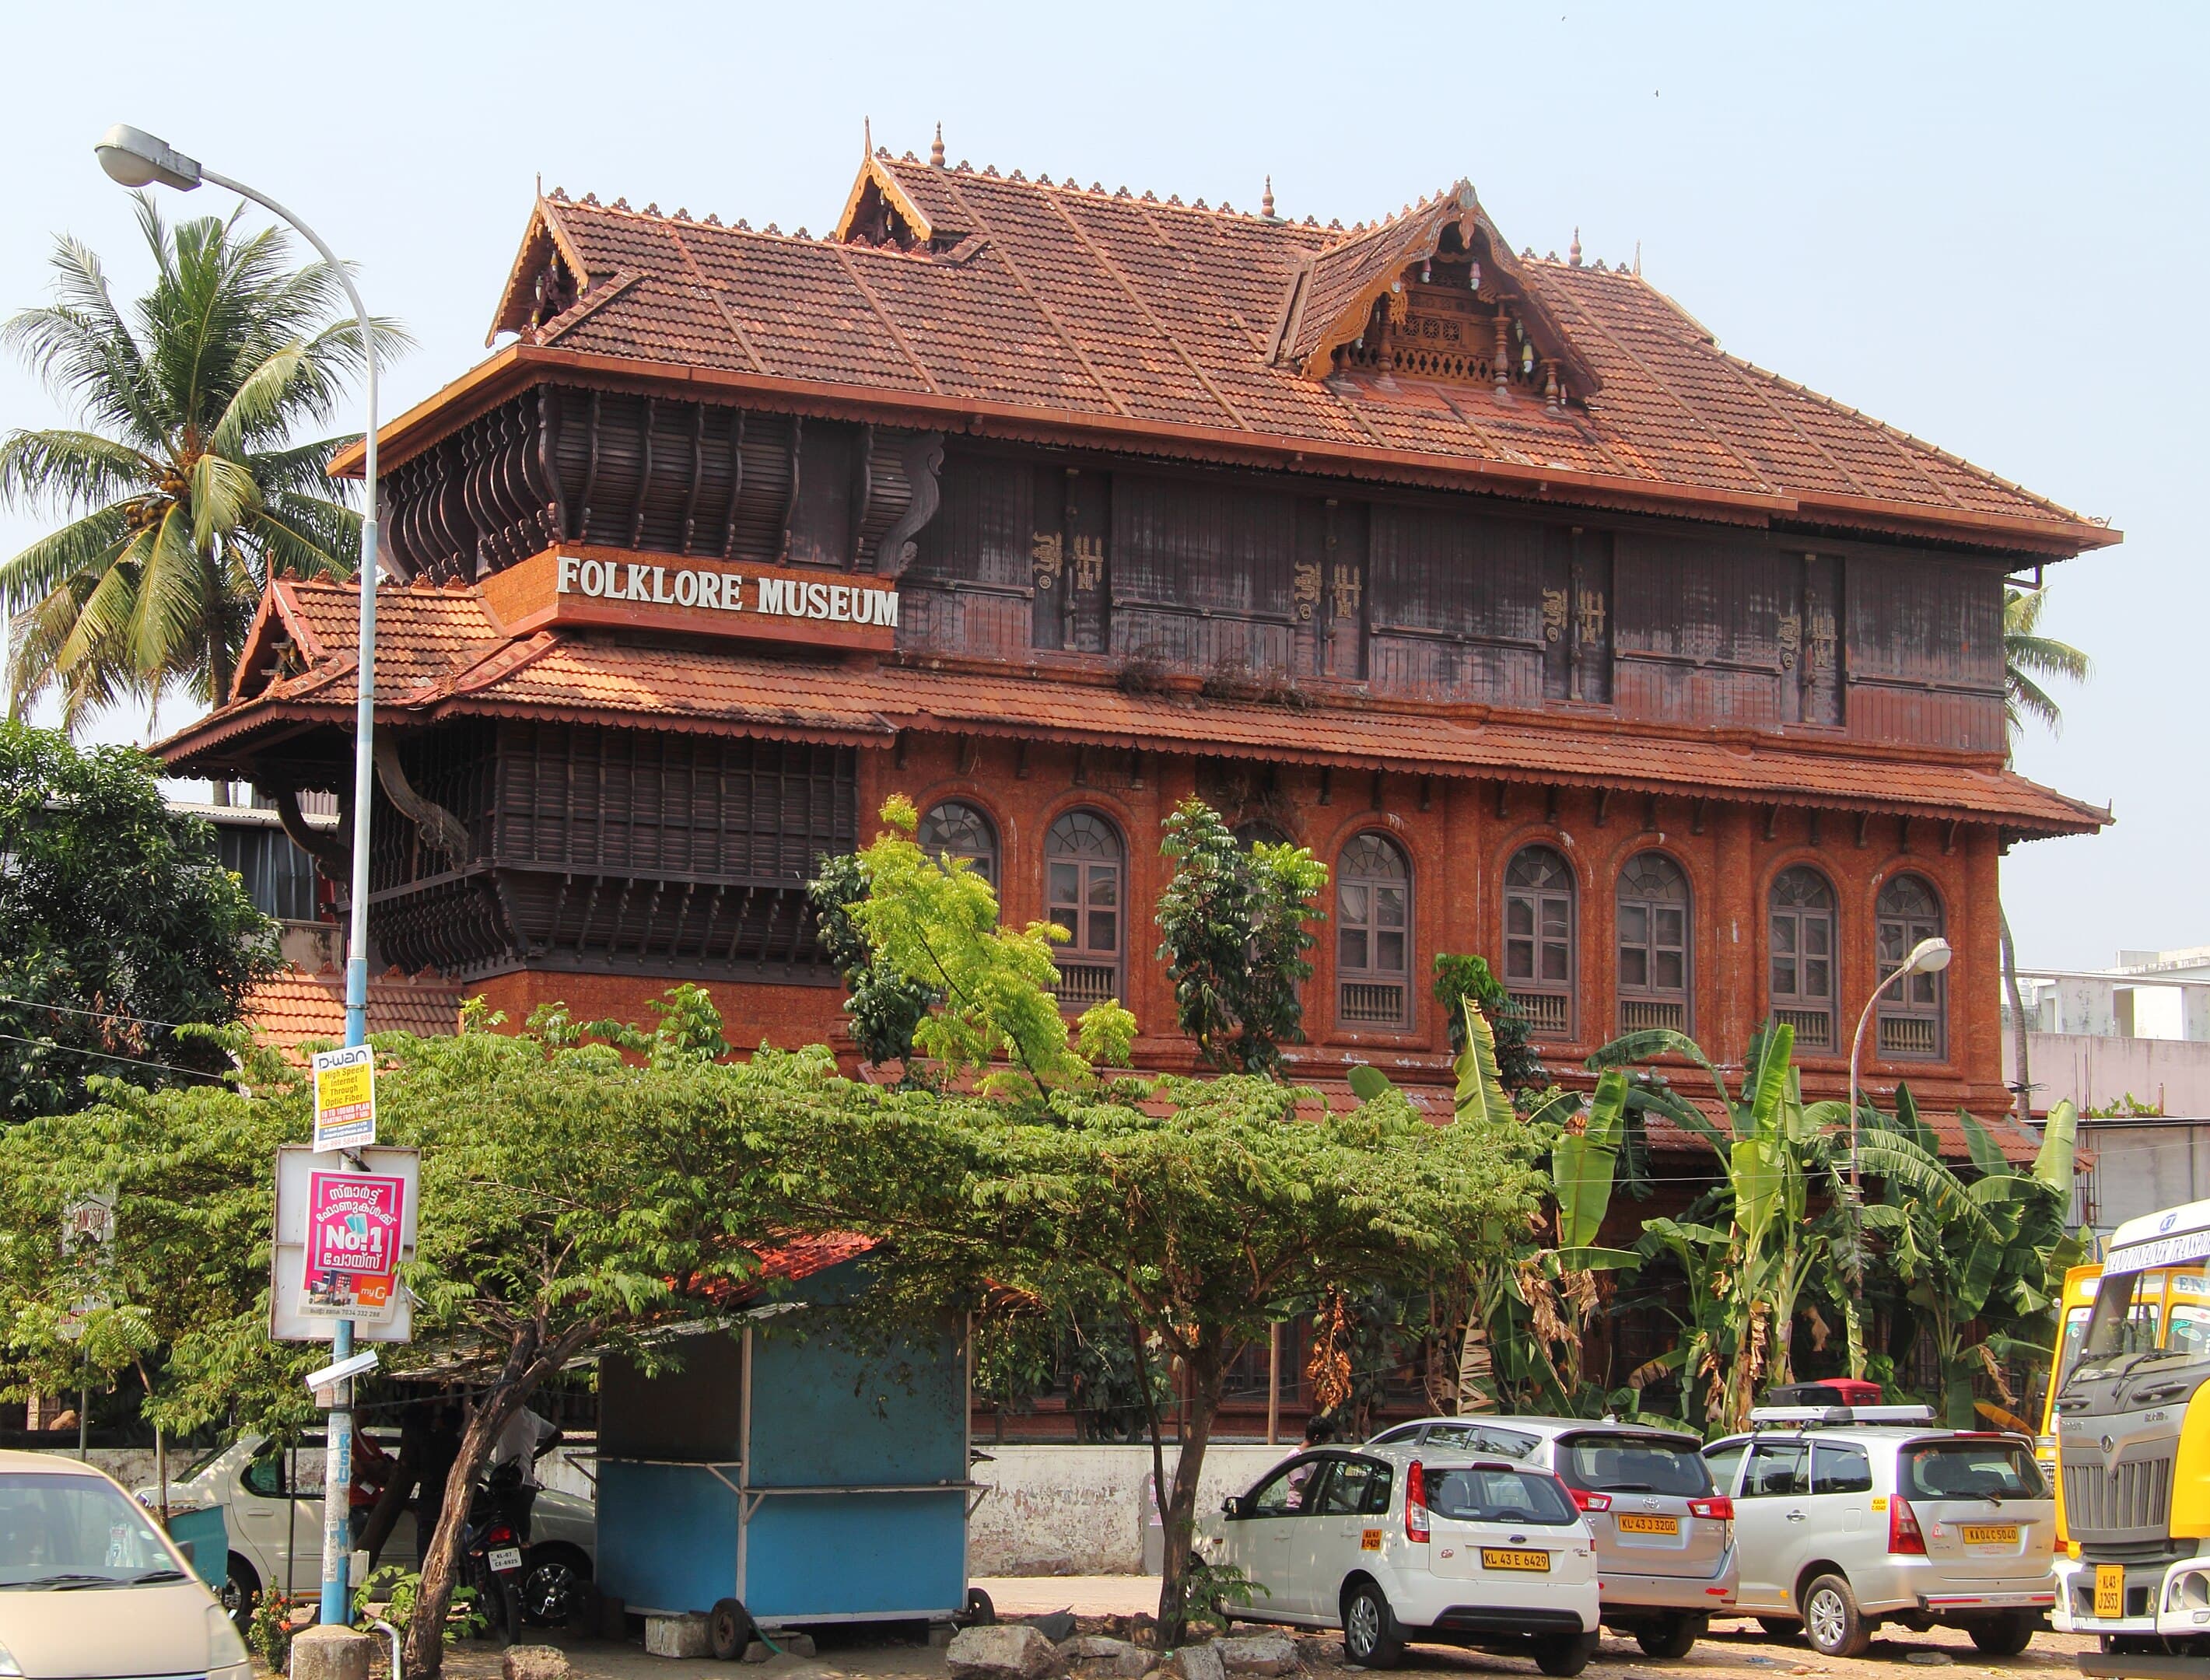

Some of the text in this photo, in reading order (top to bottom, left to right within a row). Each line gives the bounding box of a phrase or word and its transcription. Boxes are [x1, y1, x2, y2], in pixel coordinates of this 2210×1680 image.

[555, 555, 899, 628] FOLKLORE MUSEUM
[325, 1066, 365, 1080] High Speed
[331, 1076, 358, 1087] Internet
[330, 1084, 358, 1096] Through
[325, 1094, 363, 1108] Optic Fiber
[329, 1108, 336, 1118] TO
[355, 1102, 370, 1112] PLAN
[321, 1115, 342, 1125] STARTING
[2169, 1231, 2210, 1262] TRANSPO
[360, 1286, 386, 1300] myG
[1622, 1518, 1676, 1531] KL 43 J 3200
[1484, 1553, 1547, 1566] KL 43 E 6429
